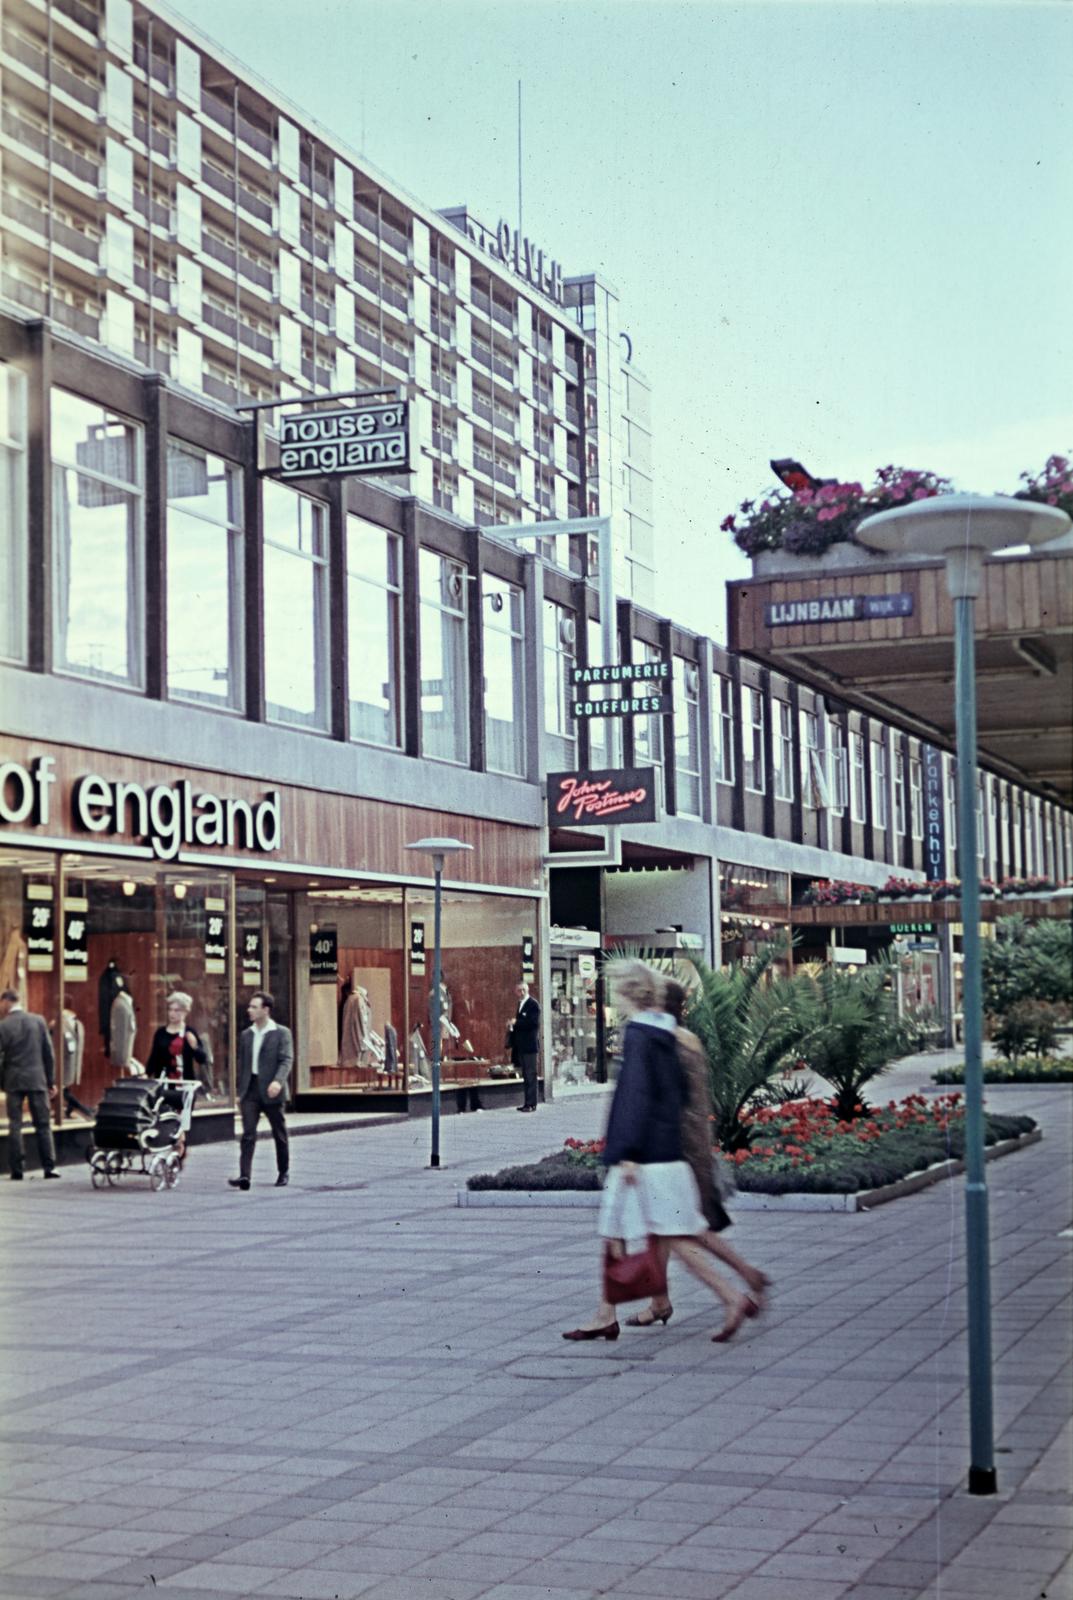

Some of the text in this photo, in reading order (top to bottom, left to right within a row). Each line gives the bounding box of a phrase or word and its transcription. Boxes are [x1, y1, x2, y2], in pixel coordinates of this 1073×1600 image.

[281, 408, 404, 442] house of
[281, 432, 406, 473] england
[771, 599, 855, 624] LIJNBAAN
[574, 664, 668, 682] PARFUMERIE
[574, 698, 660, 716] COIFFURES
[0, 756, 281, 860] of england
[557, 779, 612, 812] John
[573, 789, 646, 820] Postmus
[926, 743, 941, 883] rankenhui
